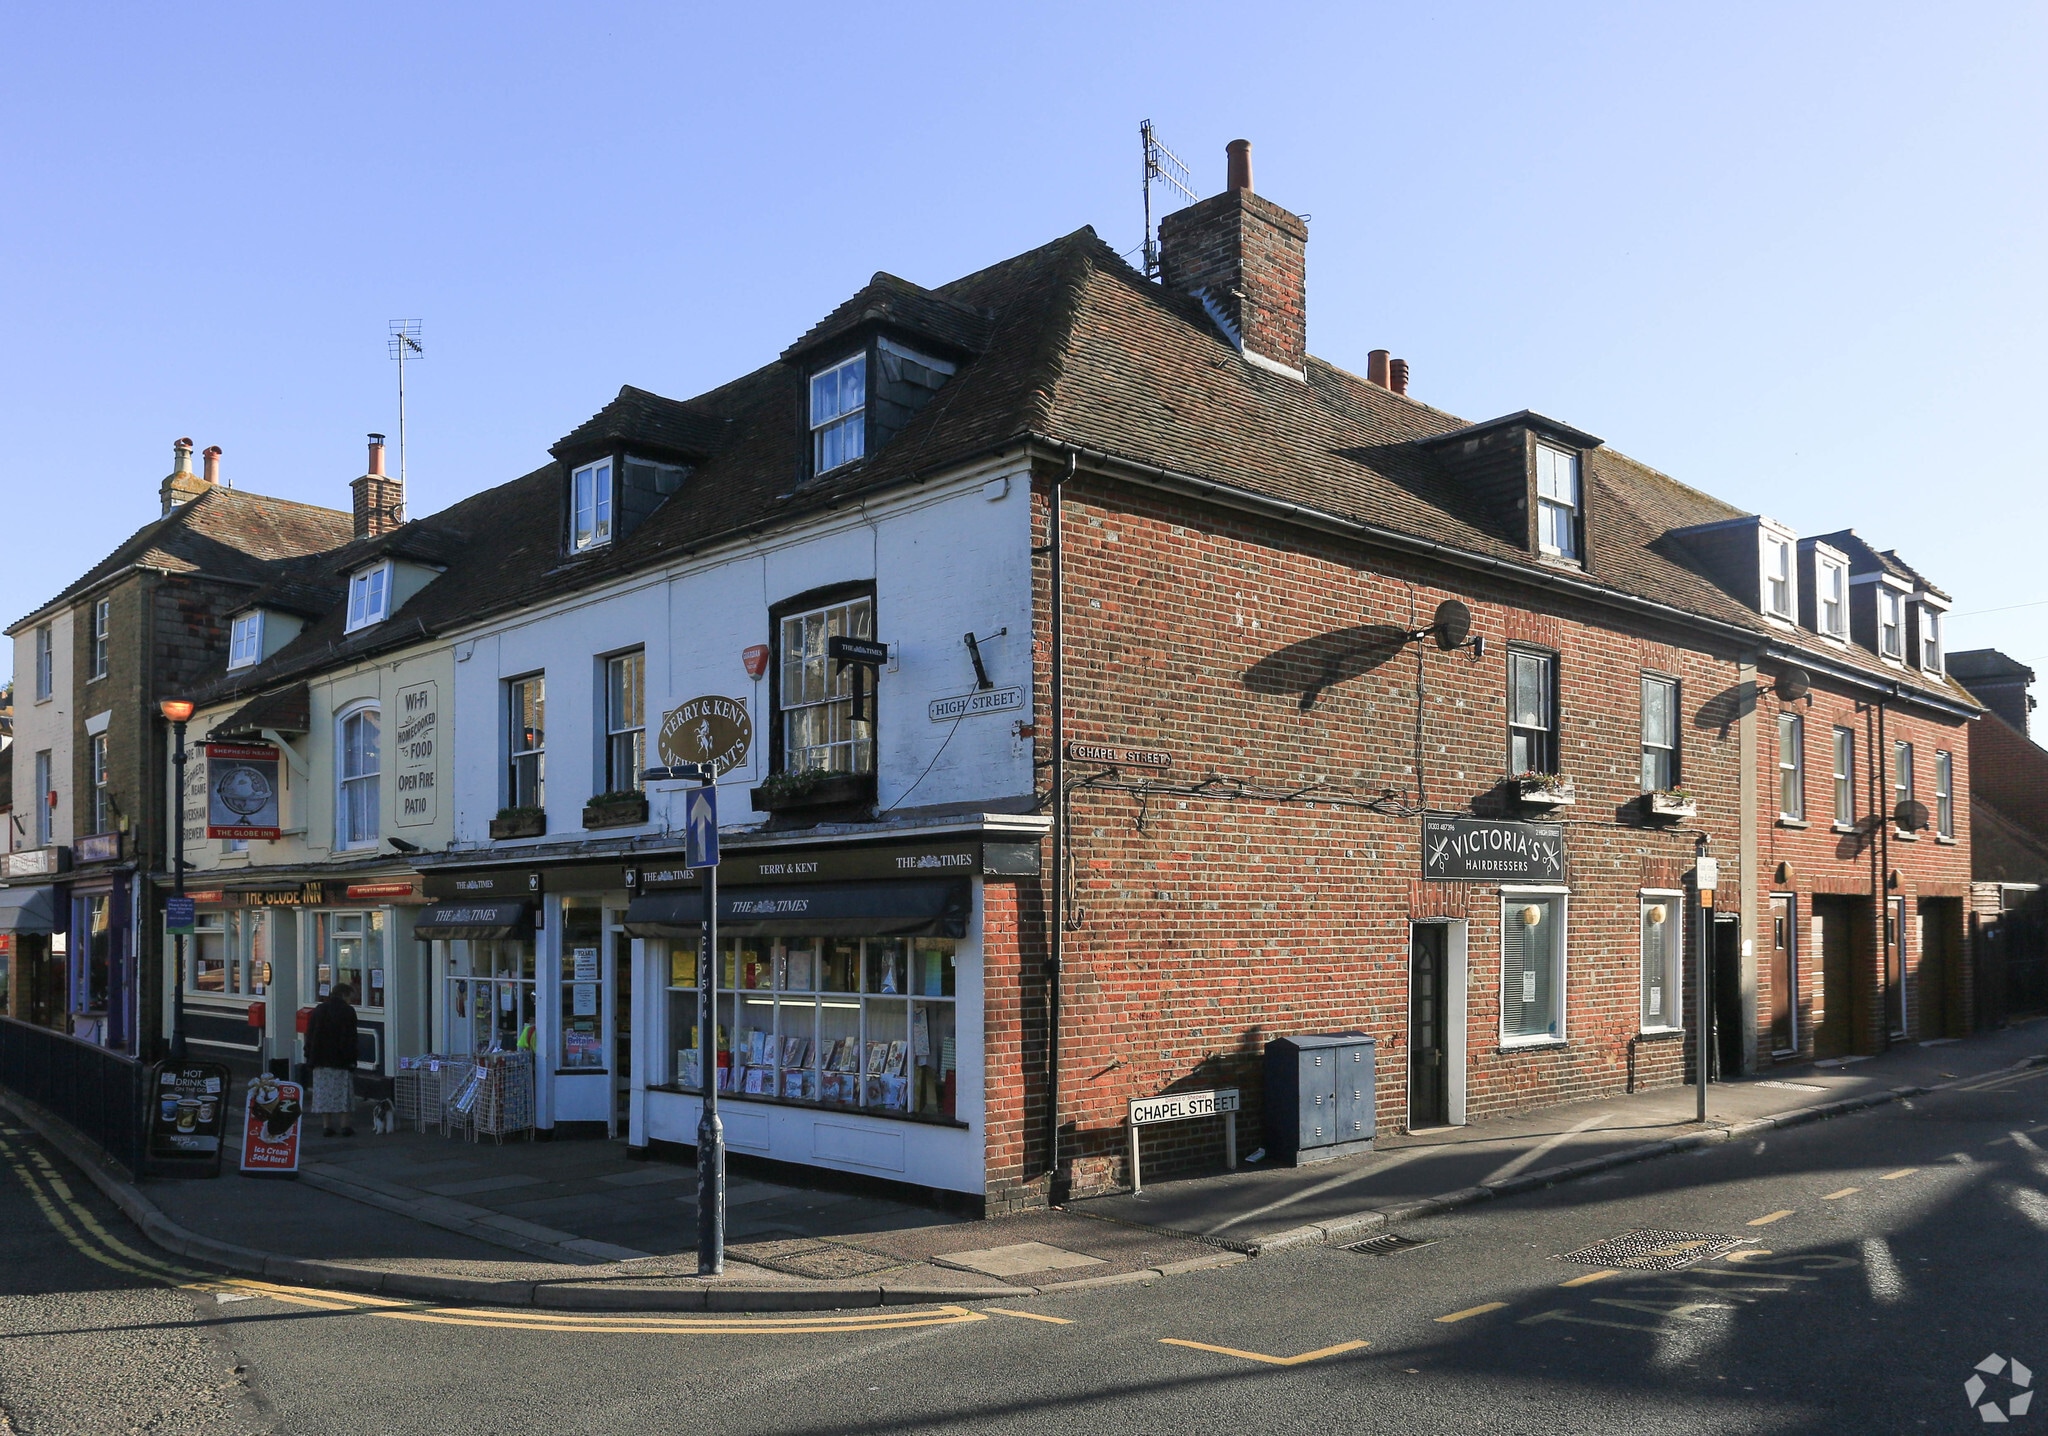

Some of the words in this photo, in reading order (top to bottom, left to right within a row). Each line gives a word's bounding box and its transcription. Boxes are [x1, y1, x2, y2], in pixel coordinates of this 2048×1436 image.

[866, 648, 882, 656] TIMES
[405, 690, 428, 711] Wi-Fi
[936, 700, 965, 715] HIGH
[972, 692, 1016, 710] STREET
[663, 702, 699, 738] TERRY
[701, 700, 711, 715] &
[713, 699, 746, 728] KENT
[397, 712, 436, 744] HOMECOOKED
[410, 740, 433, 759] FOOD
[1078, 747, 1118, 760] CHAPEL
[1126, 752, 1165, 765] STREET
[399, 775, 417, 792] OPEN
[419, 771, 434, 789] FIRE
[191, 783, 206, 796] NEAME
[404, 797, 427, 815] PATIO
[1451, 829, 1541, 862] VICTORIA'S
[759, 863, 786, 875] TERRY
[787, 864, 795, 874] &
[795, 862, 818, 873] KENT
[896, 857, 917, 869] THE
[940, 854, 972, 867] TIMES
[1465, 860, 1528, 872] HAIRDRESSERS
[643, 872, 658, 882] THE
[672, 870, 695, 880] TIMES
[456, 881, 467, 890] THE
[477, 880, 494, 889] TIMES
[303, 882, 322, 904] INN
[732, 901, 753, 913] THE
[776, 900, 809, 912] TIMES
[435, 910, 452, 922] THE
[470, 909, 497, 921] TIMES
[183, 1070, 203, 1078] HOT
[176, 1079, 207, 1087] DRINKS
[1134, 1102, 1186, 1122] CHAPEL
[1189, 1096, 1236, 1114] STREET
[266, 1147, 289, 1155] Cream
